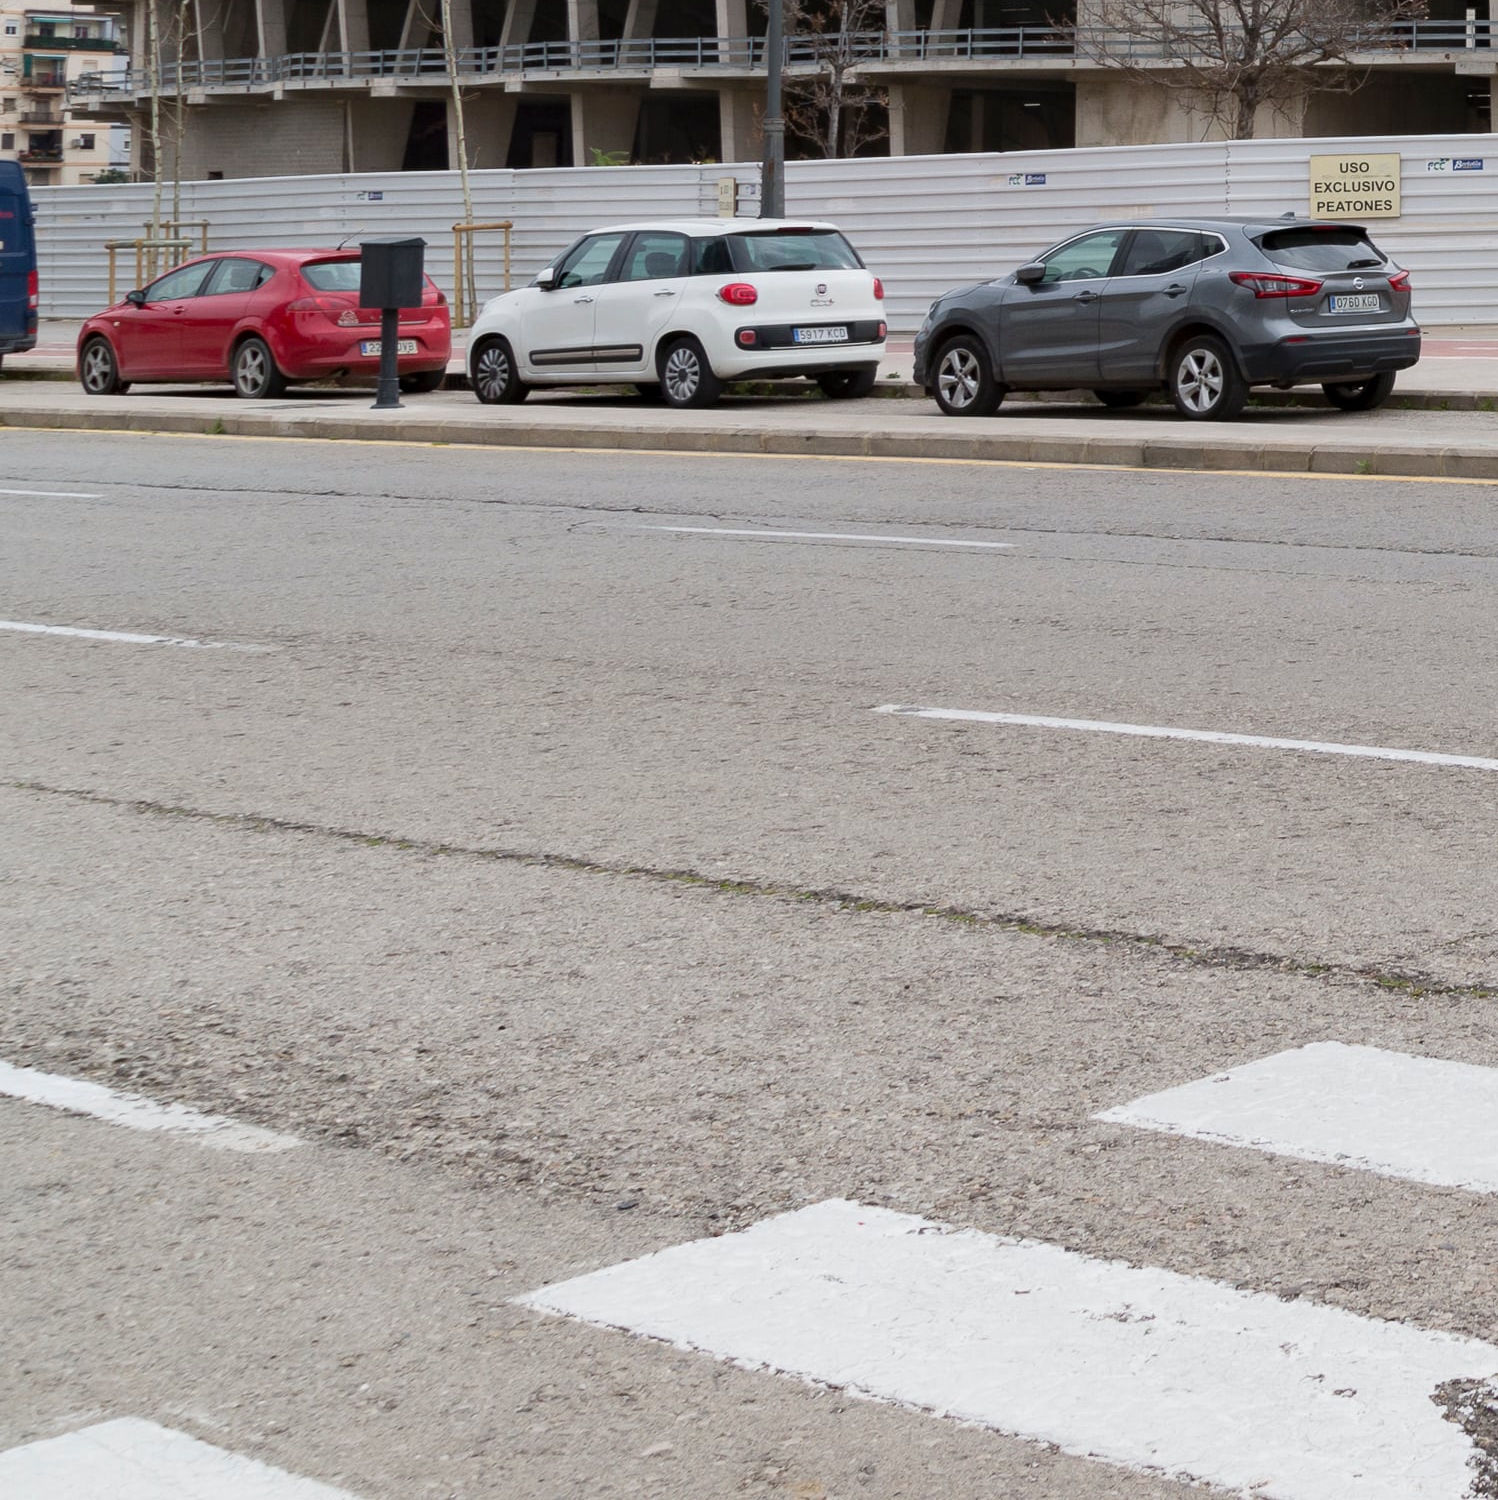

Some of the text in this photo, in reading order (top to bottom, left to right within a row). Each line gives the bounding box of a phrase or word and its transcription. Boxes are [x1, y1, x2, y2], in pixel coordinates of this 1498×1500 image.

[1339, 162, 1370, 173] USO
[1314, 180, 1395, 193] EXCLUSIVO
[1317, 199, 1393, 212] PEATONES
[1336, 297, 1360, 309] 0760
[800, 329, 825, 340] 5917
